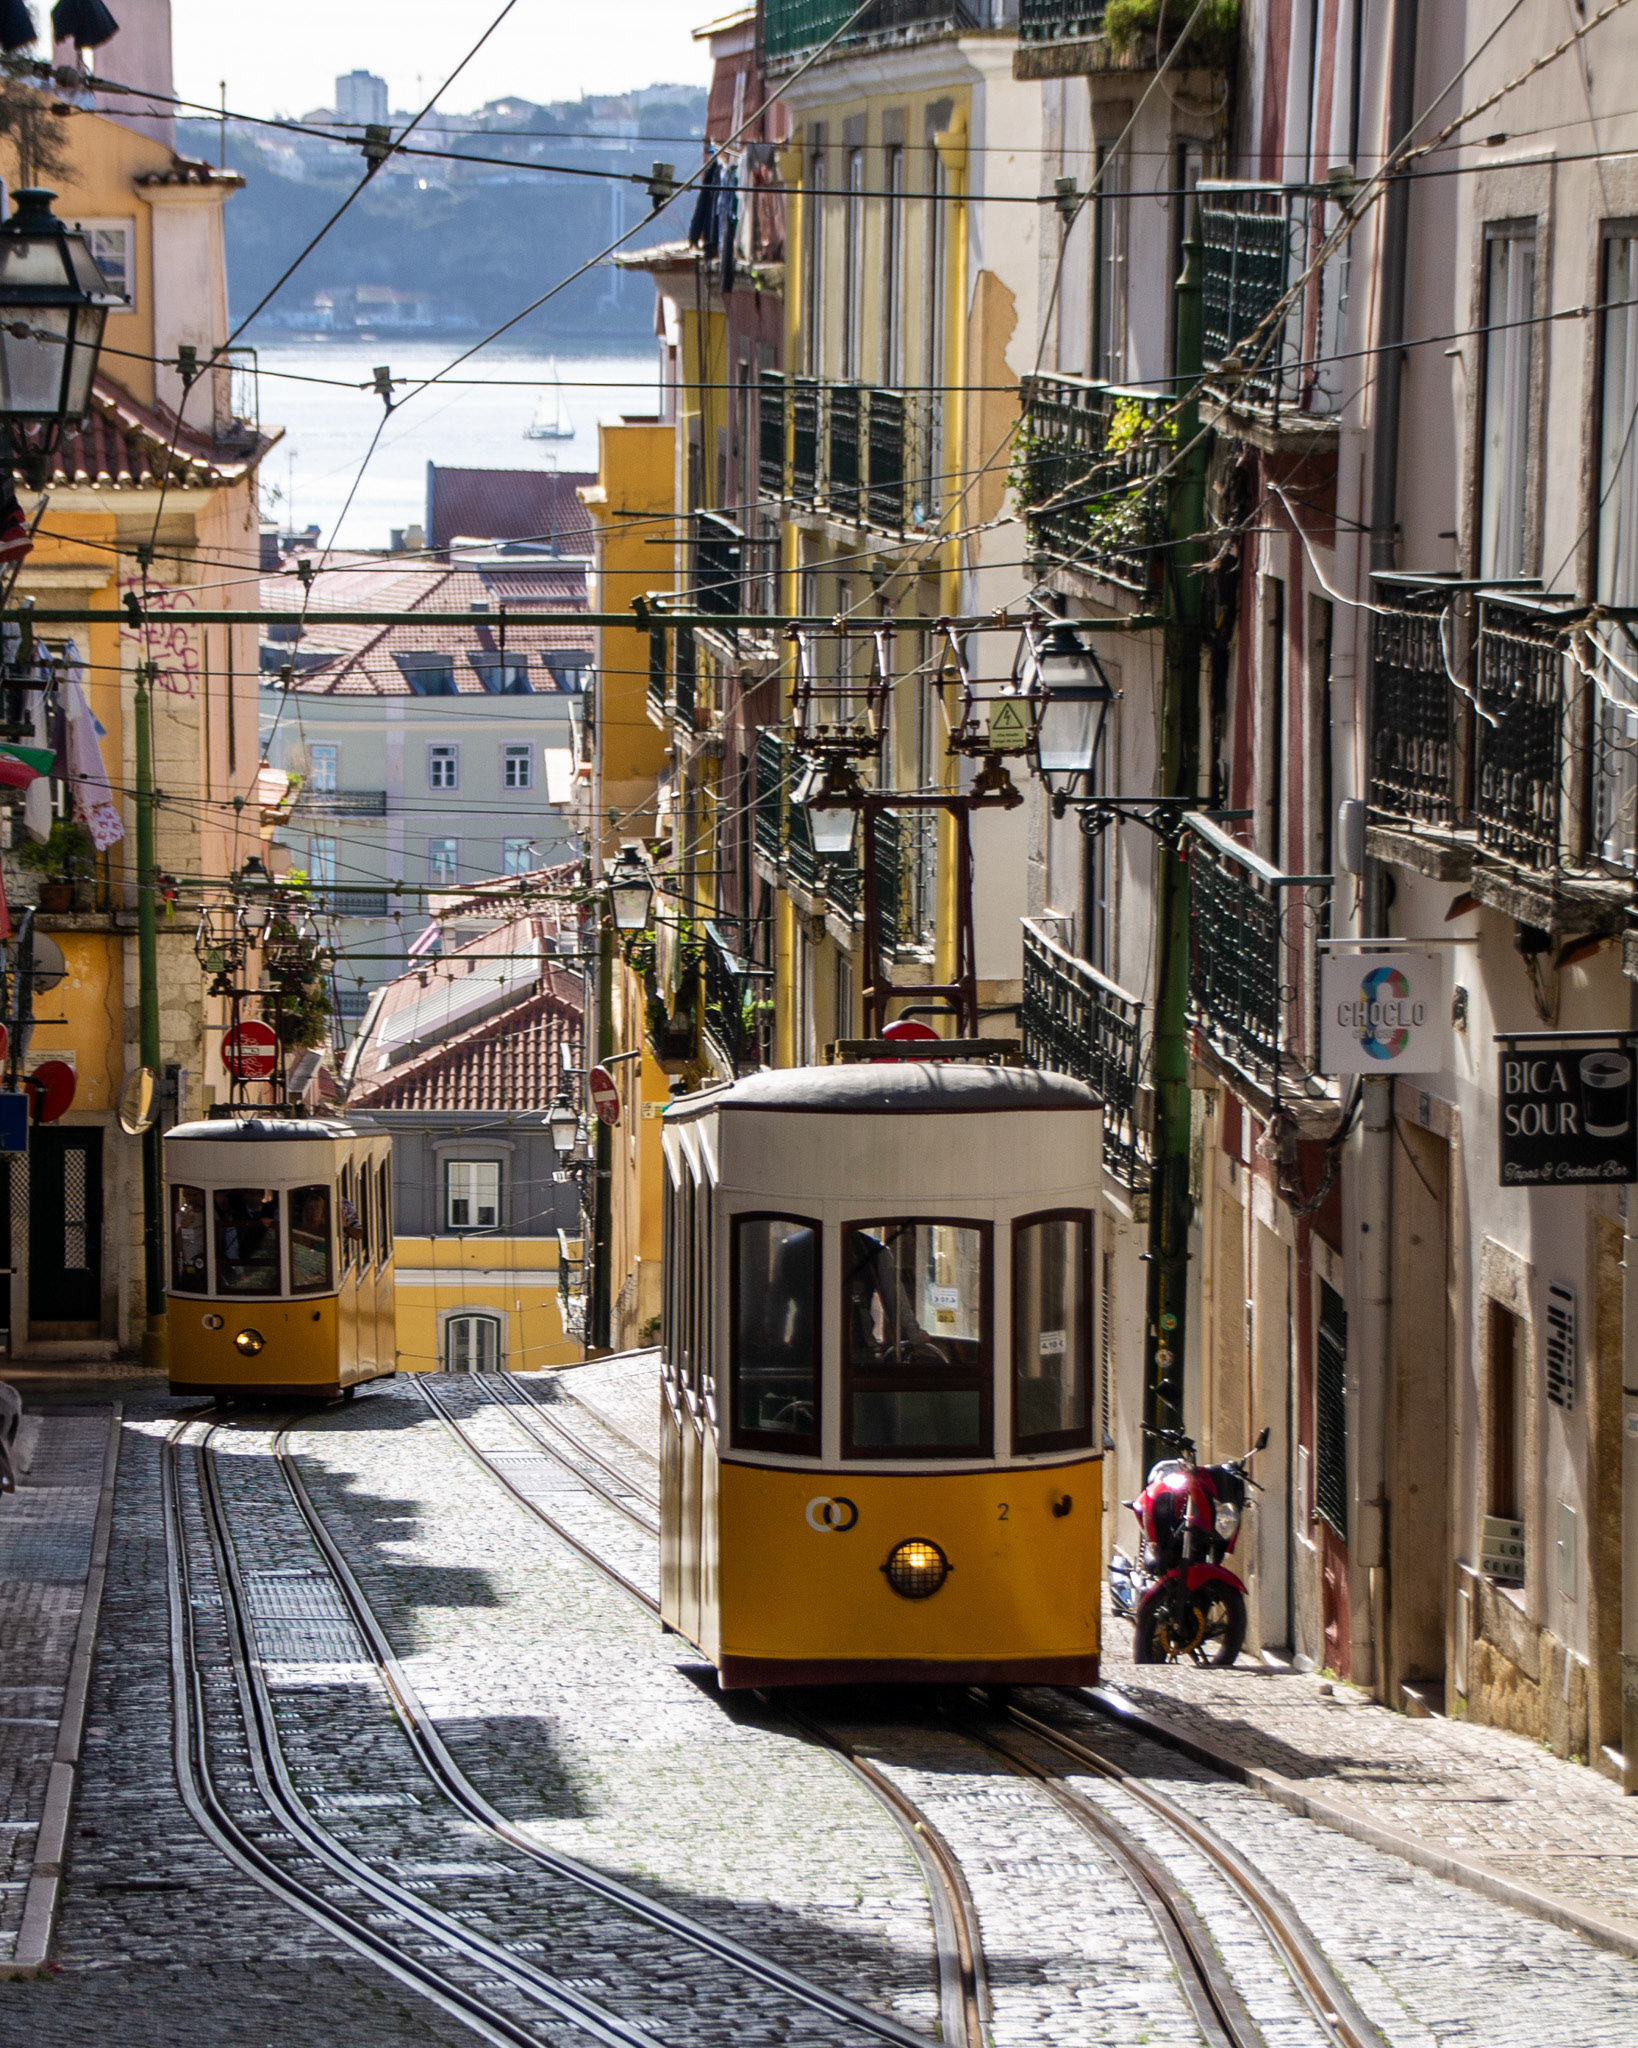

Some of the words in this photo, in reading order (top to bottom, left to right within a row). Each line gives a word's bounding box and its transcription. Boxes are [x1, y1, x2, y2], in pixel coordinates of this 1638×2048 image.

[1337, 1001, 1425, 1027] CHOCLO
[1505, 1060, 1567, 1094] BICA
[1505, 1102, 1578, 1136] SOUR
[1541, 1162, 1554, 1180] &
[1555, 1161, 1601, 1179] Cocktail
[1602, 1159, 1629, 1177] Bar
[997, 1502, 1009, 1521] 2
